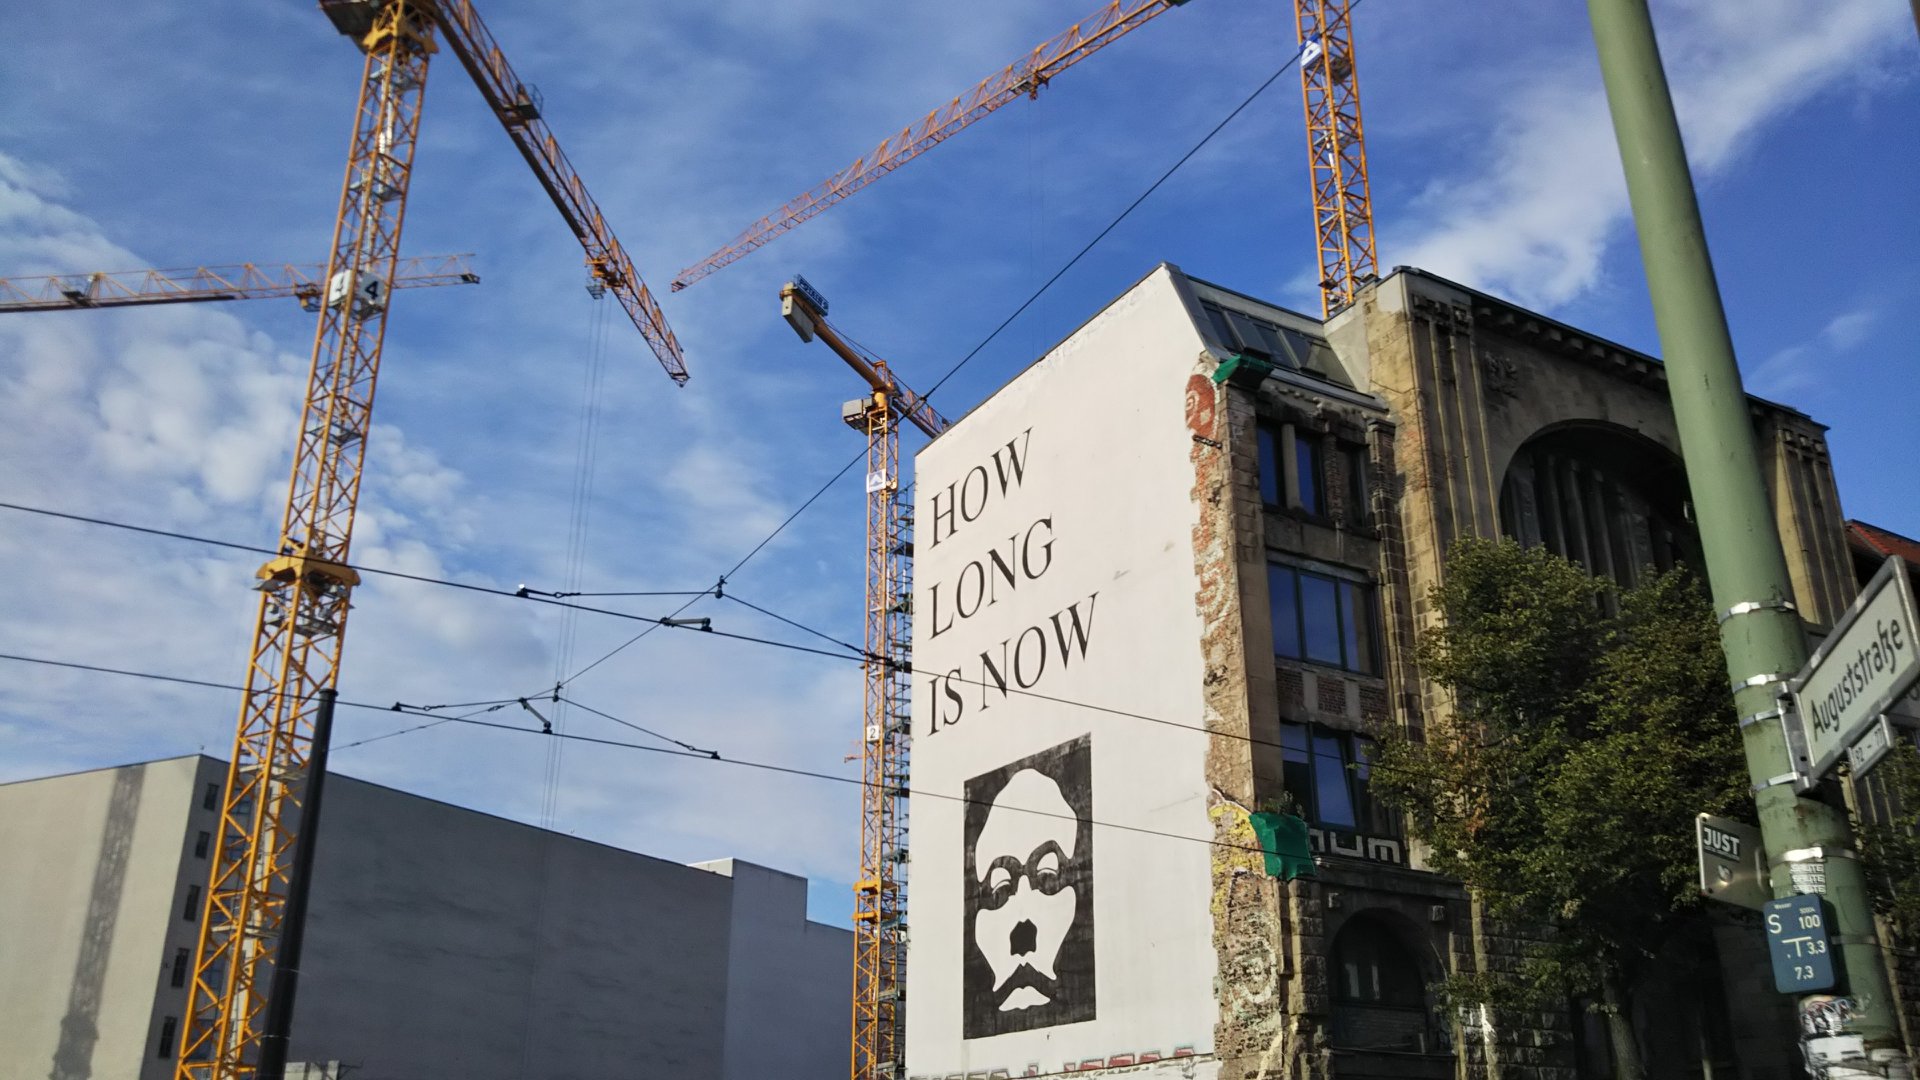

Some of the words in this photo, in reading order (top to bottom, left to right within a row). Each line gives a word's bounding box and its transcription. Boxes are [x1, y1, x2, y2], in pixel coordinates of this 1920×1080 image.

[364, 281, 378, 300] 4
[929, 426, 1034, 550] HOW
[927, 513, 1057, 640] LONG
[927, 666, 964, 737] IS
[978, 591, 1100, 712] NOW
[1810, 618, 1904, 742] Auguststraße
[869, 727, 876, 739] 2
[1703, 826, 1741, 856] JUST
[1767, 914, 1782, 934] S
[1798, 914, 1821, 930] 100
